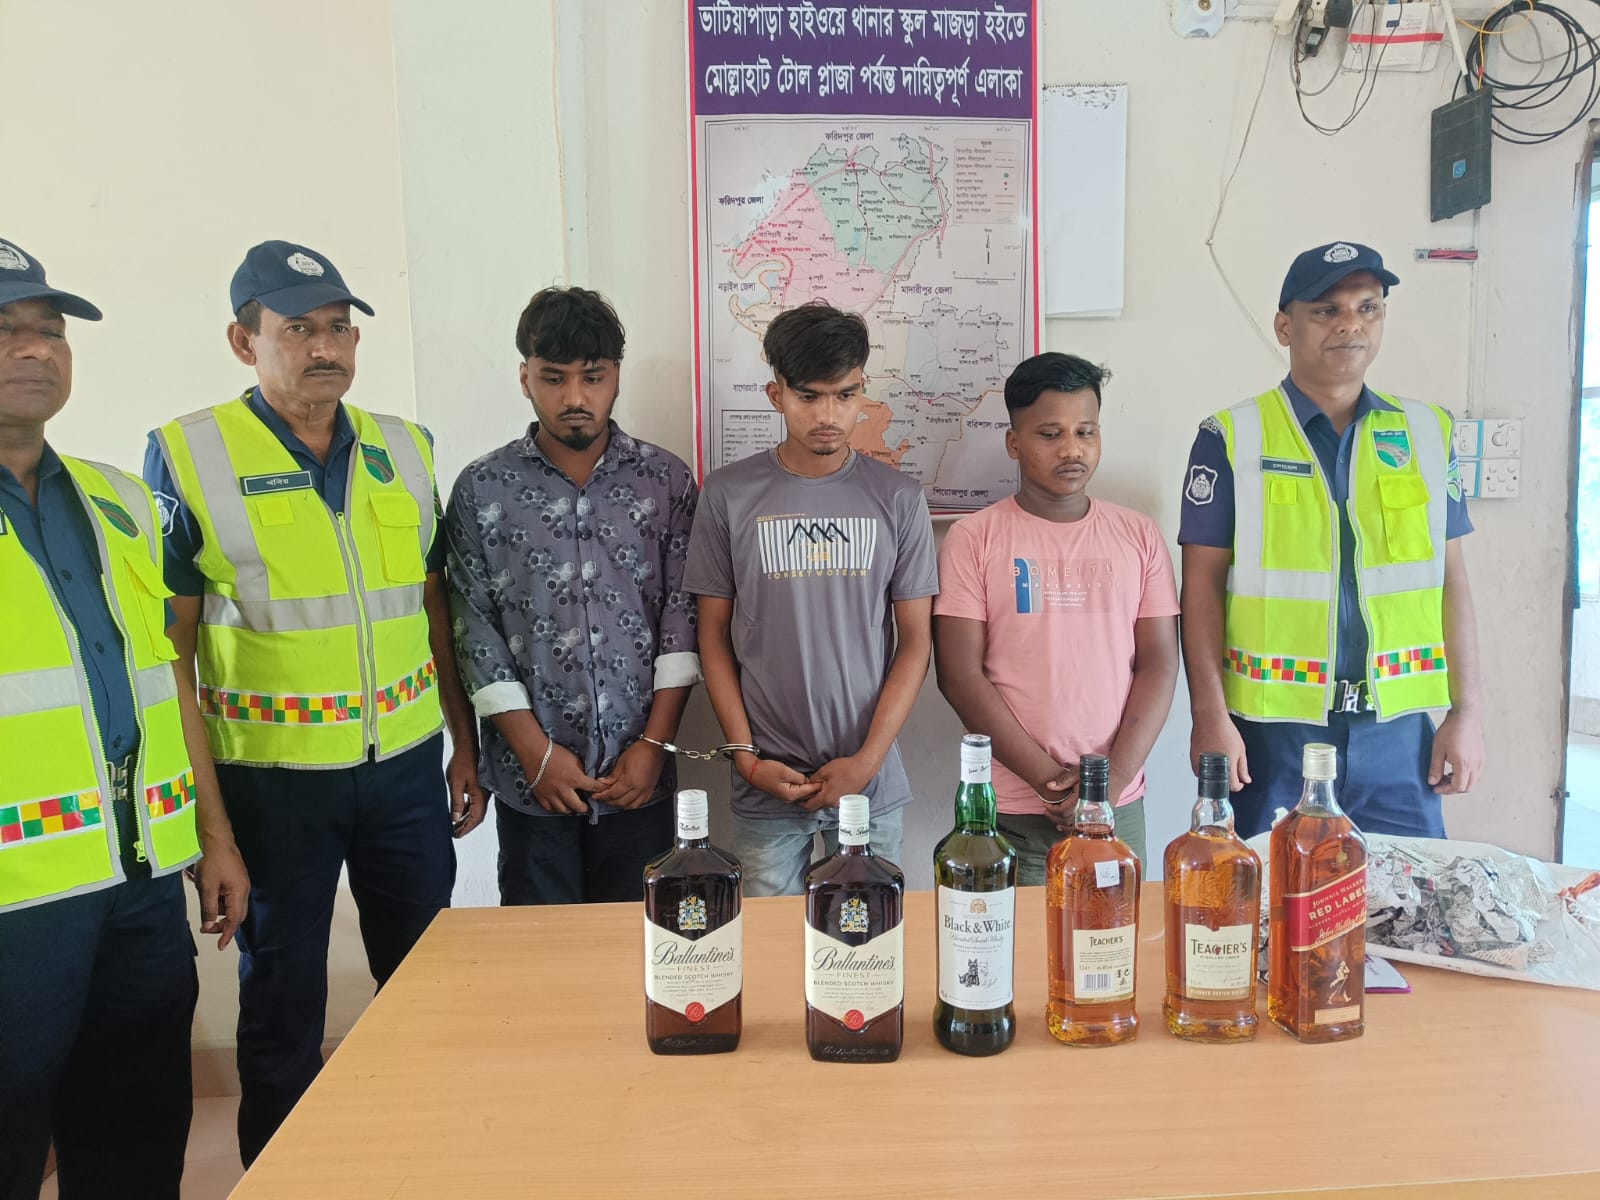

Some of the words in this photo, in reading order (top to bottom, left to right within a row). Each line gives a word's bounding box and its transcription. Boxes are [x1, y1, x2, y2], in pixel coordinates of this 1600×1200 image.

[698, 0, 784, 41] ভাটিয়াপাড়া
[787, 1, 847, 39] হাইওয়ে
[852, 5, 895, 37] থানার
[898, 9, 928, 48] স্কুল
[931, 8, 980, 45] মাজড়া
[984, 2, 1027, 45] হইতে
[705, 54, 772, 97] মোল্লাহাট
[777, 54, 813, 95] টোল
[818, 61, 855, 97] প্লাজা
[860, 54, 897, 95] পর্যন্ত
[900, 56, 969, 107] দায়িত্বপূর্ণ
[975, 66, 1023, 99] এলাকা
[825, 131, 853, 142] ফরিদপুর
[855, 132, 874, 141] জেলা
[719, 195, 745, 206] ফরিদপুর
[747, 196, 764, 205] জেলা
[718, 281, 738, 293] নড়াইল
[740, 283, 756, 292] জেলা
[901, 283, 932, 295] মাদারীপুর
[934, 286, 952, 295] জেলা
[933, 487, 968, 498] পিরোজপুর
[970, 489, 989, 497] জেলা
[1309, 904, 1332, 920] RED
[1335, 886, 1366, 908] LABEL
[652, 940, 735, 965] Ballantine's
[811, 946, 896, 971] Ballantine's
[677, 964, 711, 972] FINEST
[836, 971, 870, 979] FINEST
